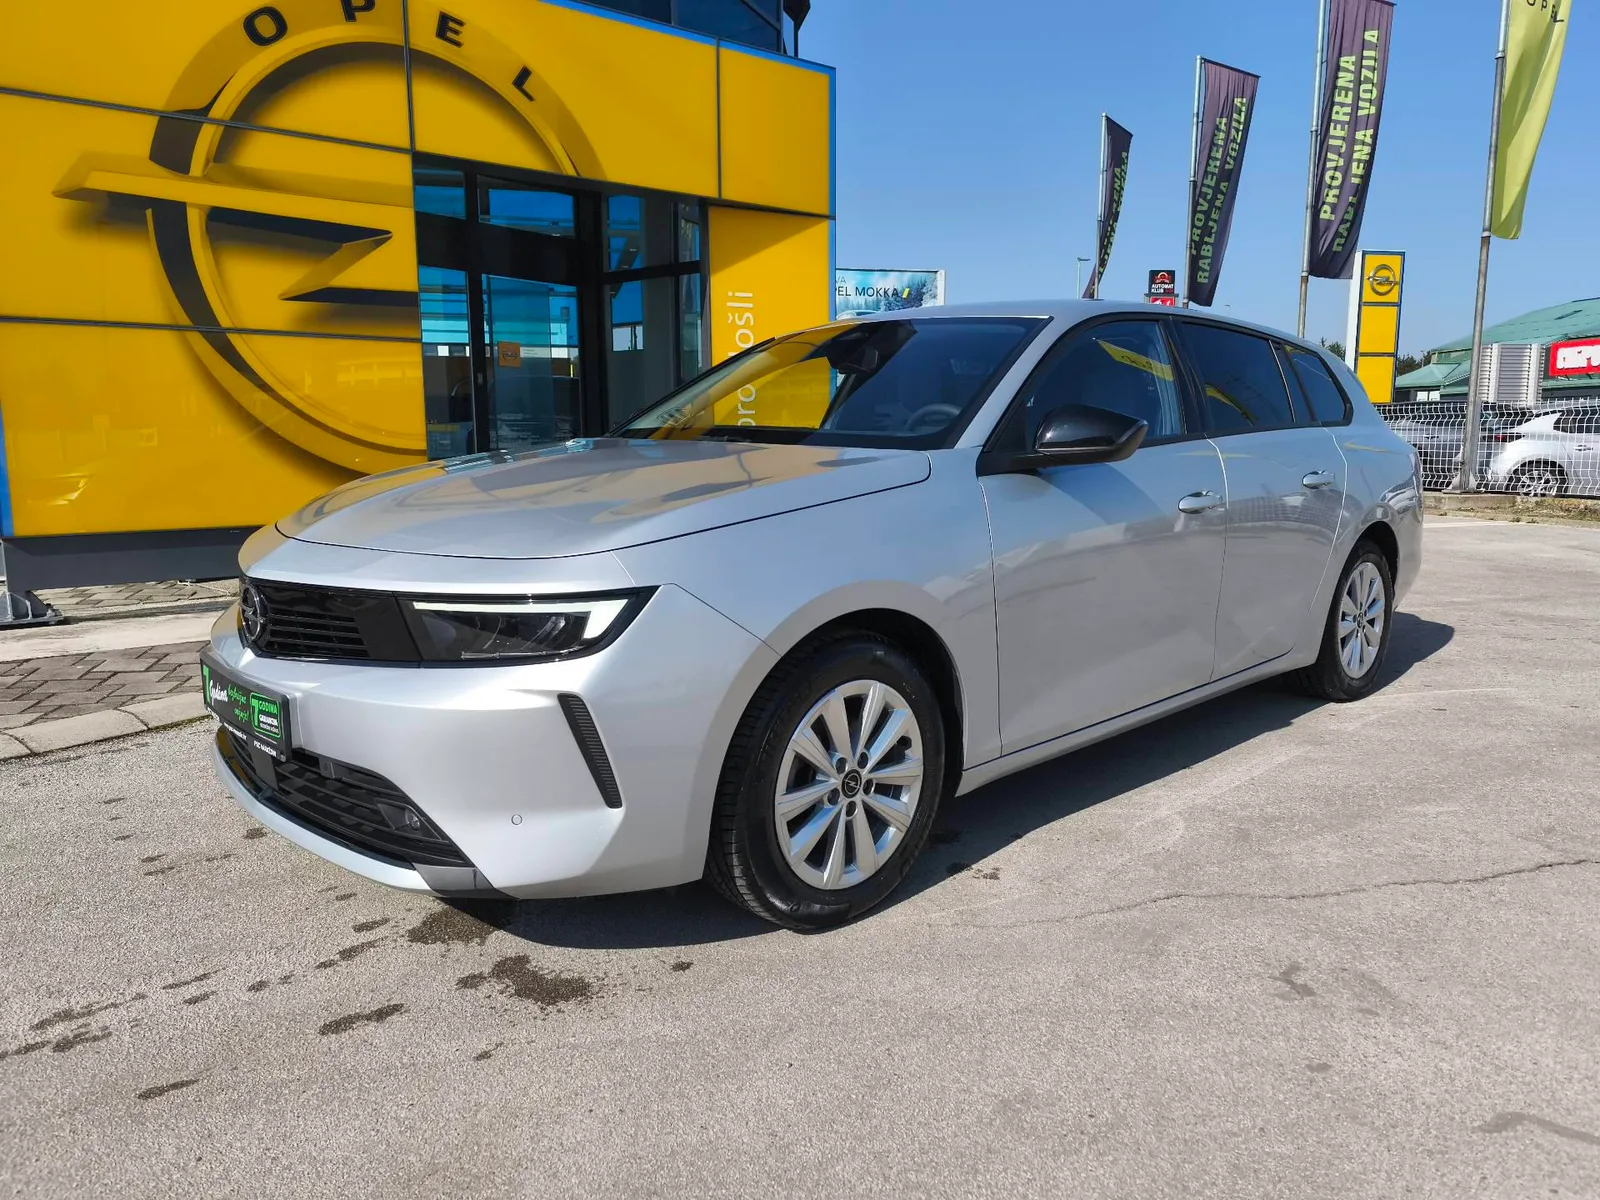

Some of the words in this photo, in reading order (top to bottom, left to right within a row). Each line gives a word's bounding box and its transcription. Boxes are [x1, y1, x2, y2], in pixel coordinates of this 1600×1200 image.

[243, 0, 535, 102] OPEL
[1319, 54, 1356, 221] PROVJERENA
[1196, 180, 1229, 284] RABLJENA
[836, 286, 852, 297] EL
[855, 286, 900, 298] MOKKA
[259, 700, 278, 714] GODINA
